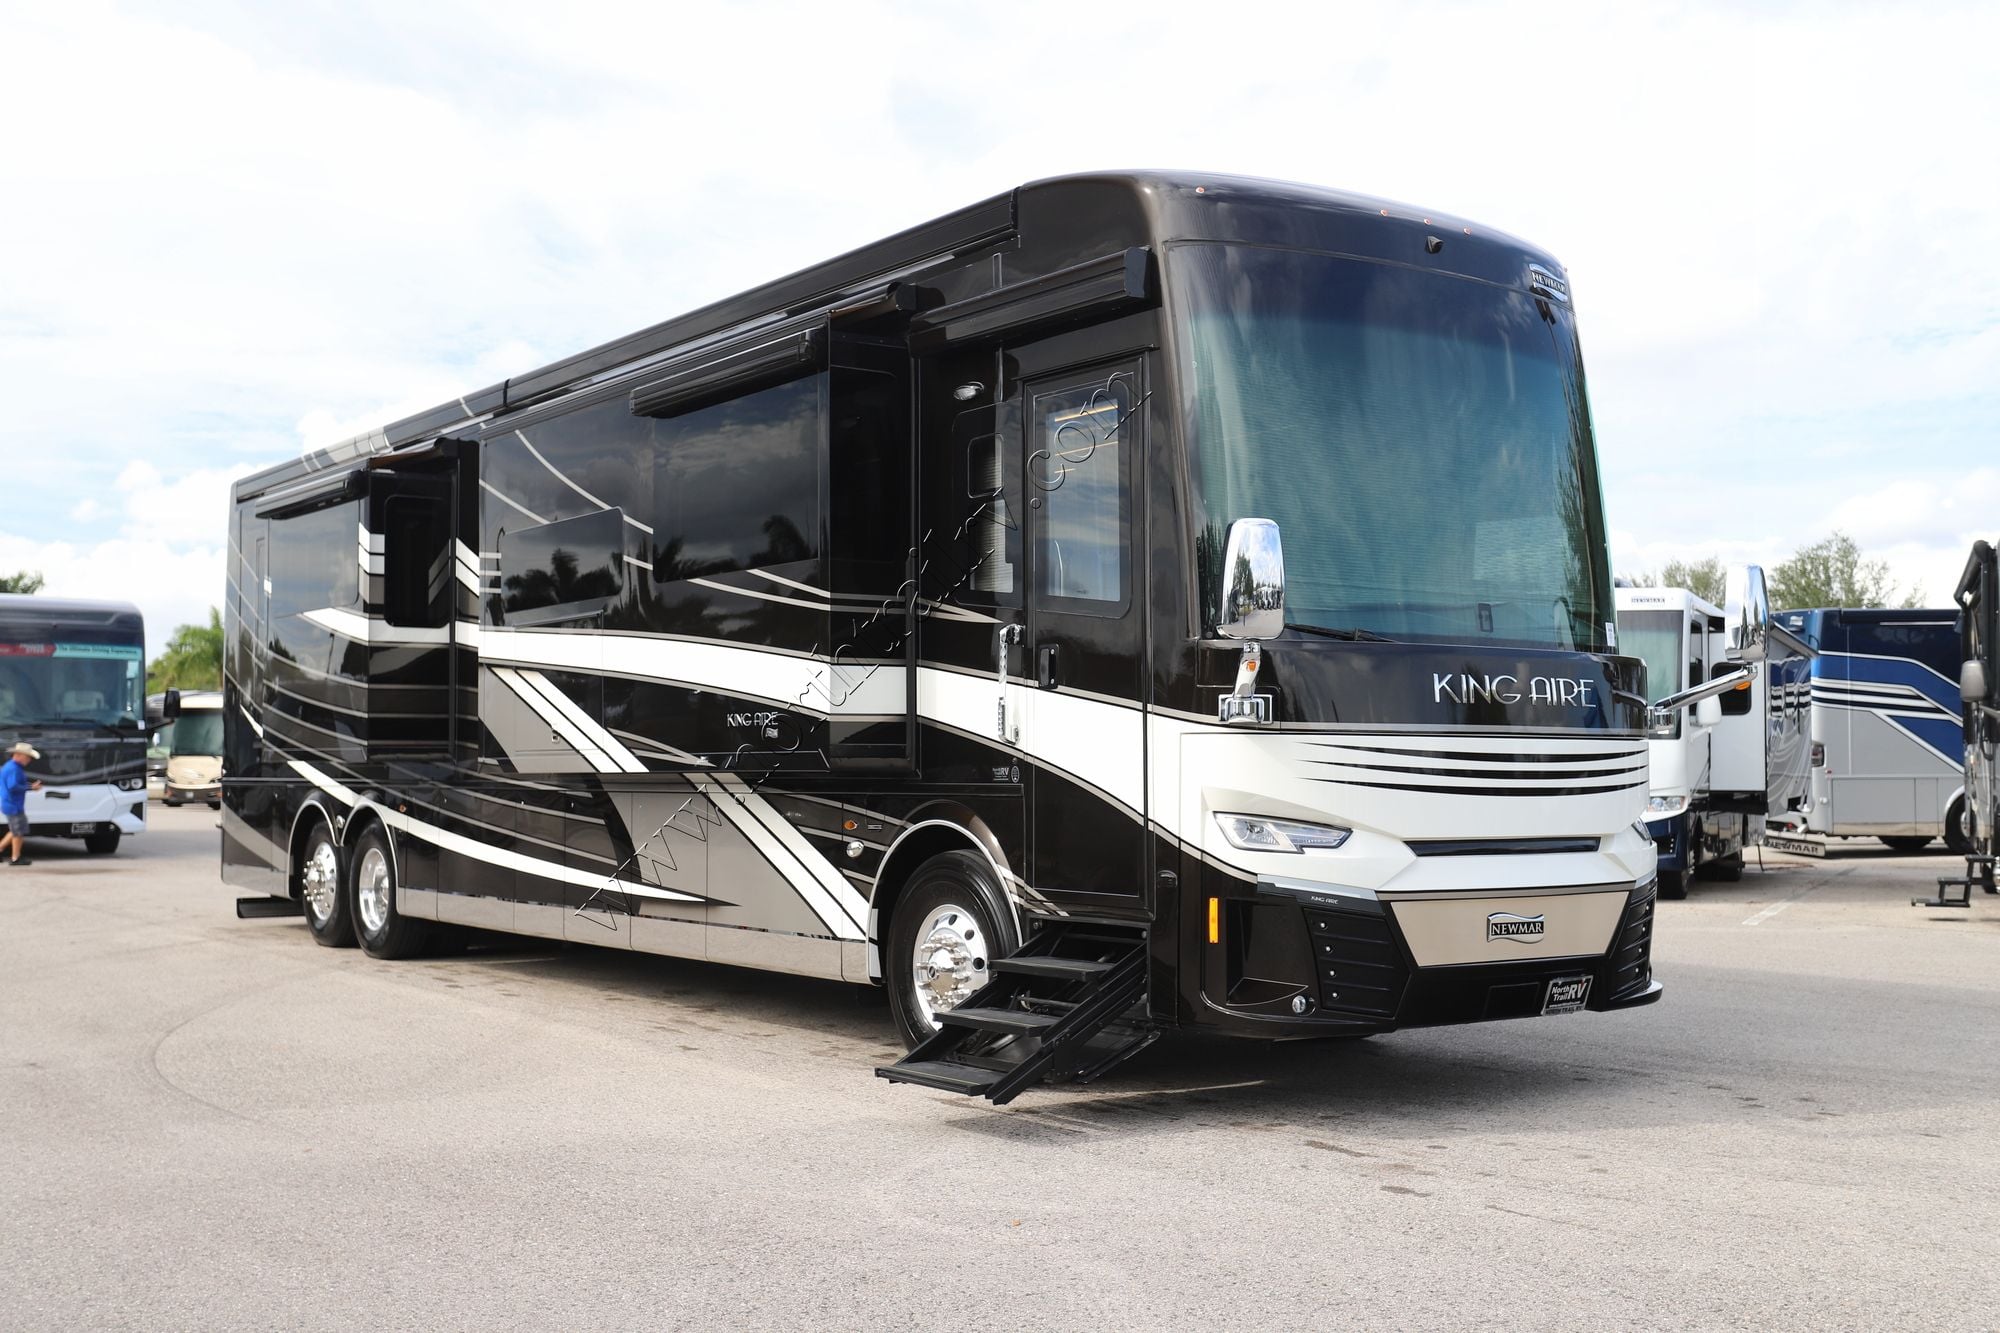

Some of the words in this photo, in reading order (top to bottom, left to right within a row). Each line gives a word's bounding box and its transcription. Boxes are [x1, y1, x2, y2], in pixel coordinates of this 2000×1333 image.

[1532, 272, 1565, 292] NEWMAR
[1433, 672, 1521, 705] KING
[1528, 676, 1597, 708] AIRE
[727, 713, 752, 727] KING
[754, 711, 779, 726] AIRE
[1310, 895, 1325, 903] KING
[1325, 897, 1339, 905] AIRE
[1492, 922, 1543, 935] NEWMAR
[1552, 986, 1569, 994] North
[1553, 993, 1568, 1001] Trail
[1567, 983, 1587, 999] RV
